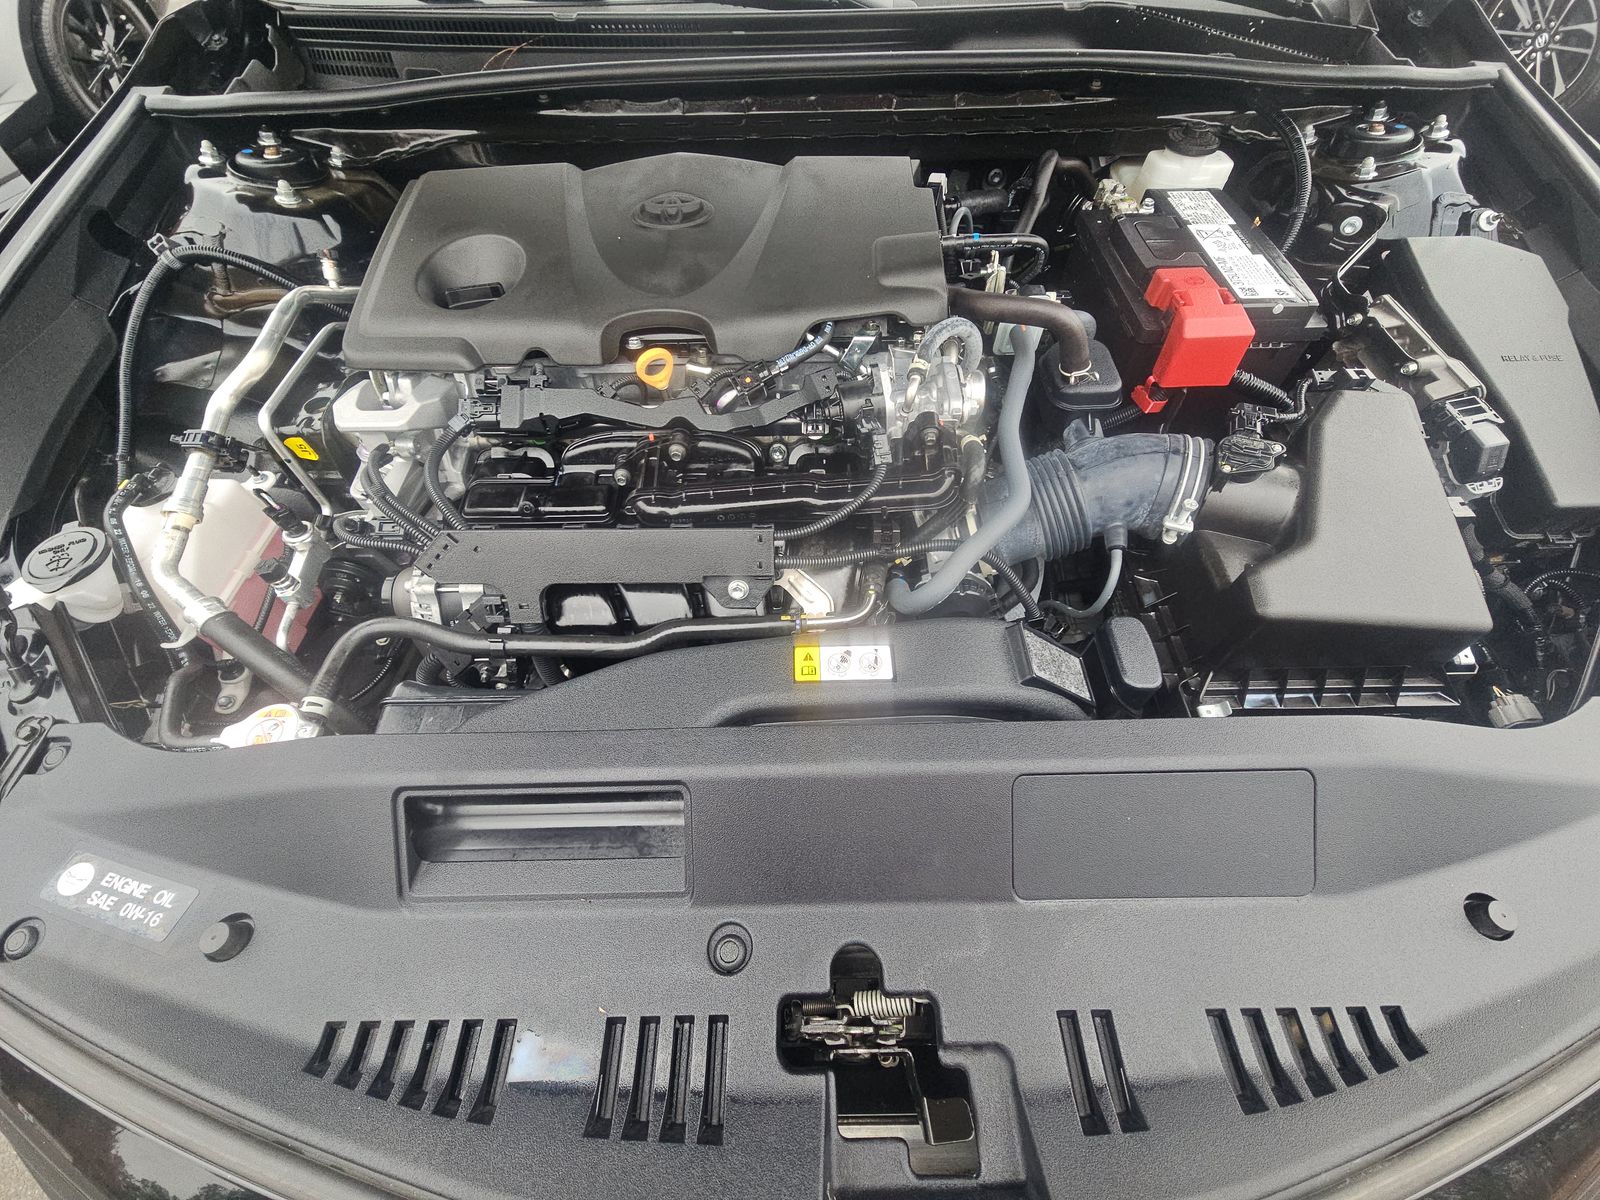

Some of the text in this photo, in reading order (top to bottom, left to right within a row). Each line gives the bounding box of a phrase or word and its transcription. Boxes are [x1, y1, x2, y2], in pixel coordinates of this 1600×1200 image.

[1500, 354, 1530, 362] RELAY
[1539, 354, 1564, 362] FUSE
[100, 872, 177, 908] ENGINE OIL
[86, 891, 163, 927] SAE 0W-16
